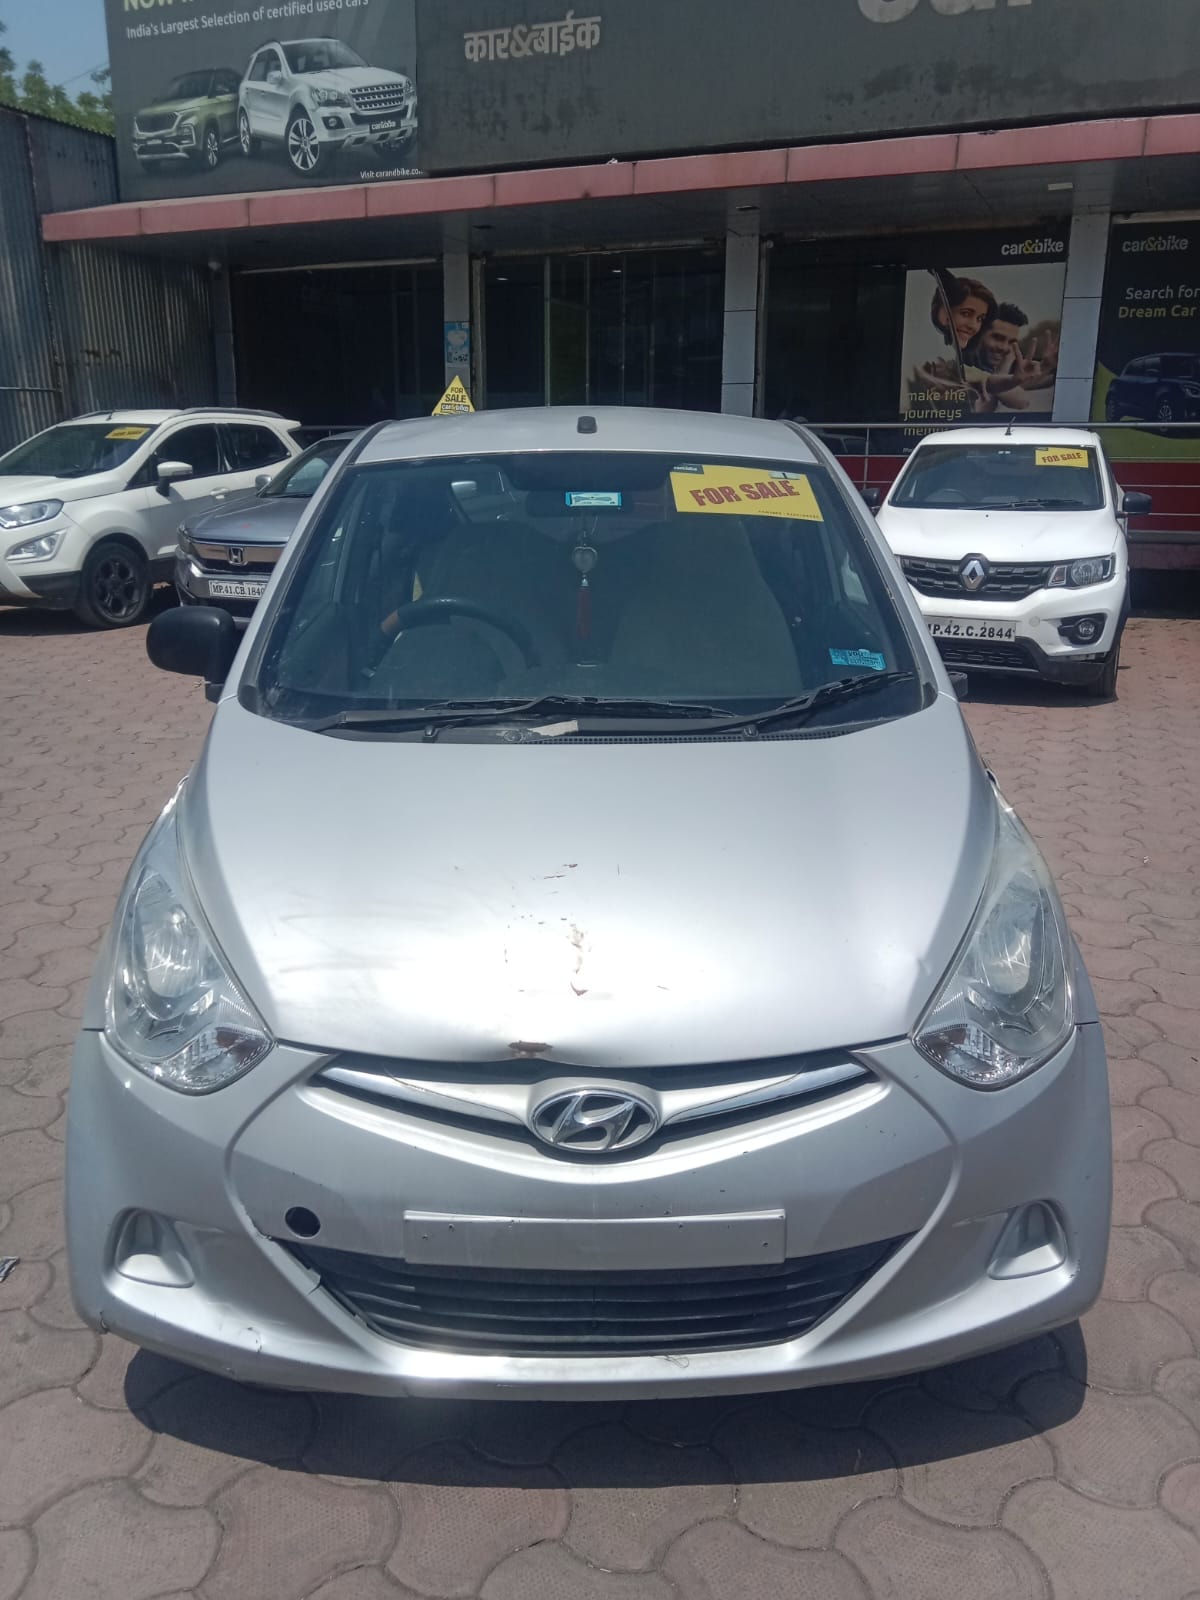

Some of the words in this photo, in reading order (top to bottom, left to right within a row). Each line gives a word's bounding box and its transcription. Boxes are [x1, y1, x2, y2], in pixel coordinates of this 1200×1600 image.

[127, 24, 159, 40] India's
[160, 17, 200, 34] Largest
[201, 10, 250, 28] Selection
[252, 6, 265, 21] of
[266, 1, 314, 19] certified
[316, 0, 343, 12] used
[463, 9, 602, 62] कार&बाईक
[360, 170, 375, 179] Visit
[1001, 238, 1064, 256] car&bike
[1122, 235, 1189, 253] car&bike
[1125, 284, 1174, 300] Search
[1178, 284, 1200, 299] for
[1119, 305, 1167, 318] Dream
[1171, 304, 1197, 317] Car
[445, 394, 467, 403] SALE
[907, 389, 941, 401] make
[945, 389, 967, 401] the
[903, 408, 962, 422] journeys
[689, 486, 742, 506] FOR
[739, 480, 801, 500] SALE
